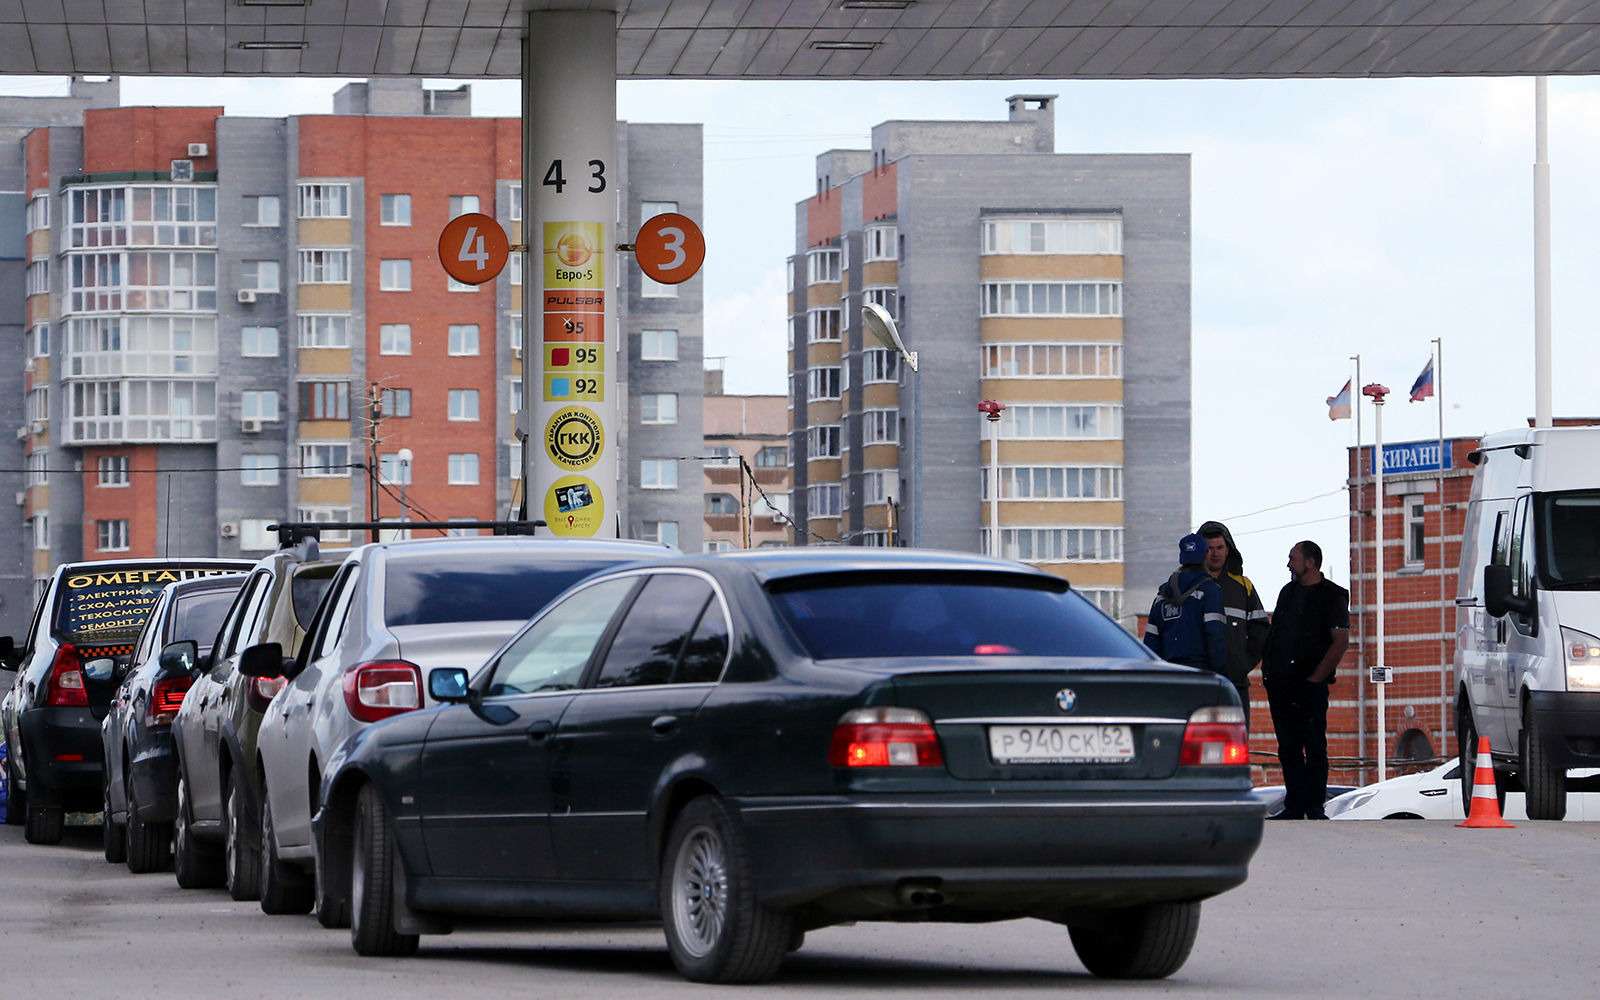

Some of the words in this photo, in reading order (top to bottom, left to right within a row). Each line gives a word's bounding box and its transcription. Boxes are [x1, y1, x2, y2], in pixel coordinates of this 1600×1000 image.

[543, 159, 566, 193] 4
[588, 159, 606, 194] 3
[458, 226, 489, 271] 4
[657, 227, 687, 271] 3
[547, 297, 603, 305] PULSAR
[565, 320, 584, 334] 95
[575, 348, 597, 363] 95
[575, 378, 597, 394] 92
[549, 412, 572, 442] ГАРАНТИЯ
[574, 412, 601, 441] КОНТРОЛЯ
[560, 432, 590, 445] ГКК
[557, 455, 594, 466] КАЧЕСТВА
[77, 589, 154, 602] ЭЛЕКТРИКА
[1102, 727, 1124, 746] 62
